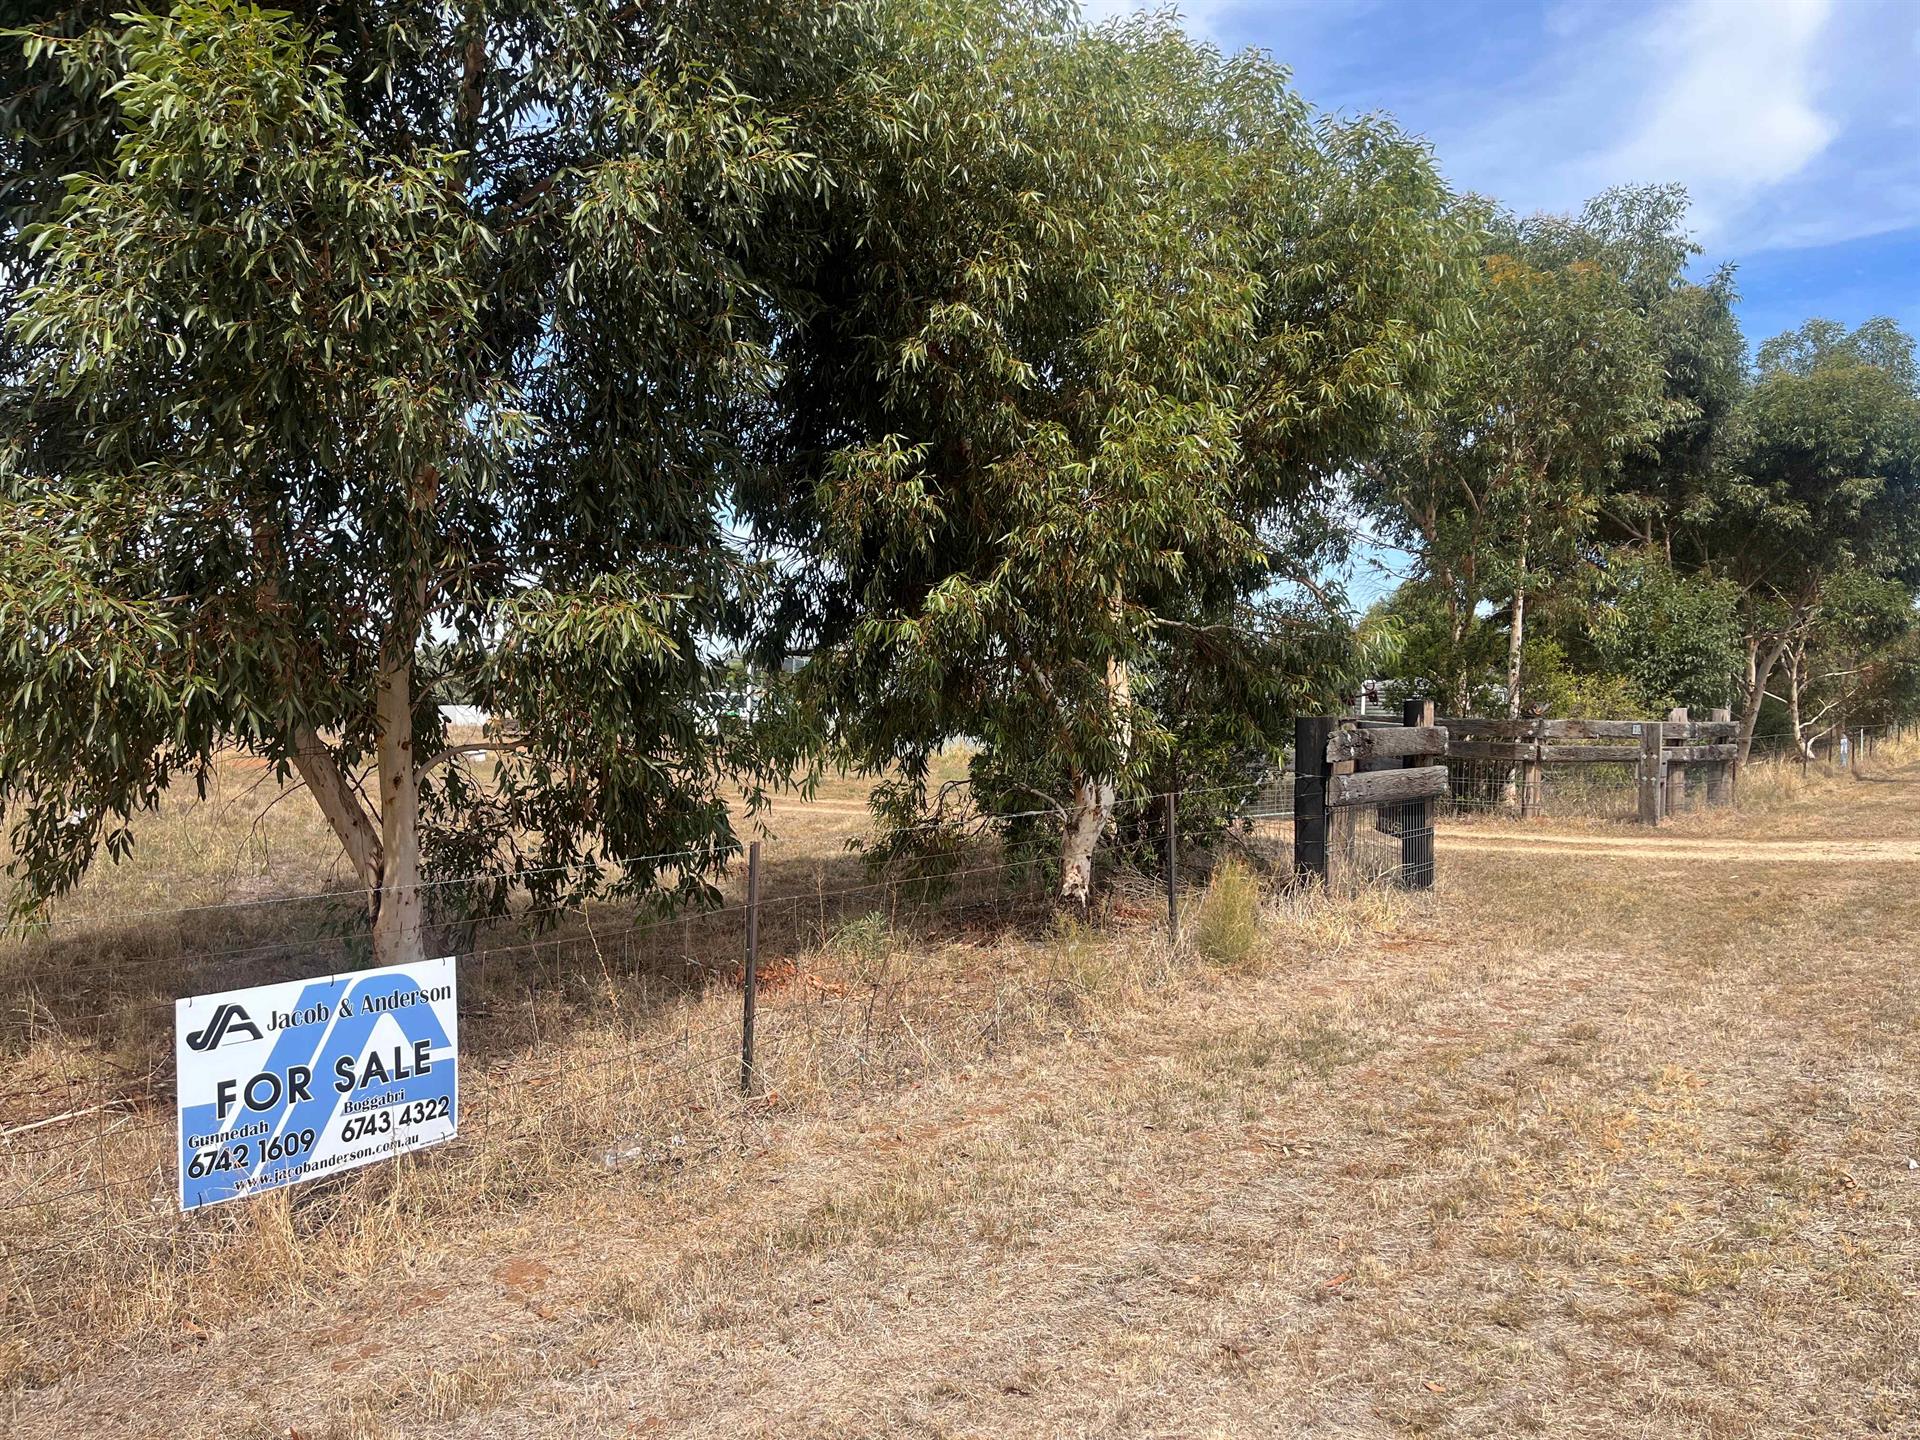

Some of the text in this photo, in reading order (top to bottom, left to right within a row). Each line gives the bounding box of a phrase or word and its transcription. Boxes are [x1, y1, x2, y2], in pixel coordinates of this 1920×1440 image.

[267, 985, 451, 1031] Jacob & Anderson
[217, 1040, 431, 1119] FOR SALE
[344, 1089, 405, 1114] Boggabri
[188, 1121, 269, 1148] Gunnedah
[341, 1096, 449, 1142] 6743 4322
[188, 1129, 315, 1179] 6742 1609
[234, 1134, 419, 1191] www.jacobanderson.com.au
